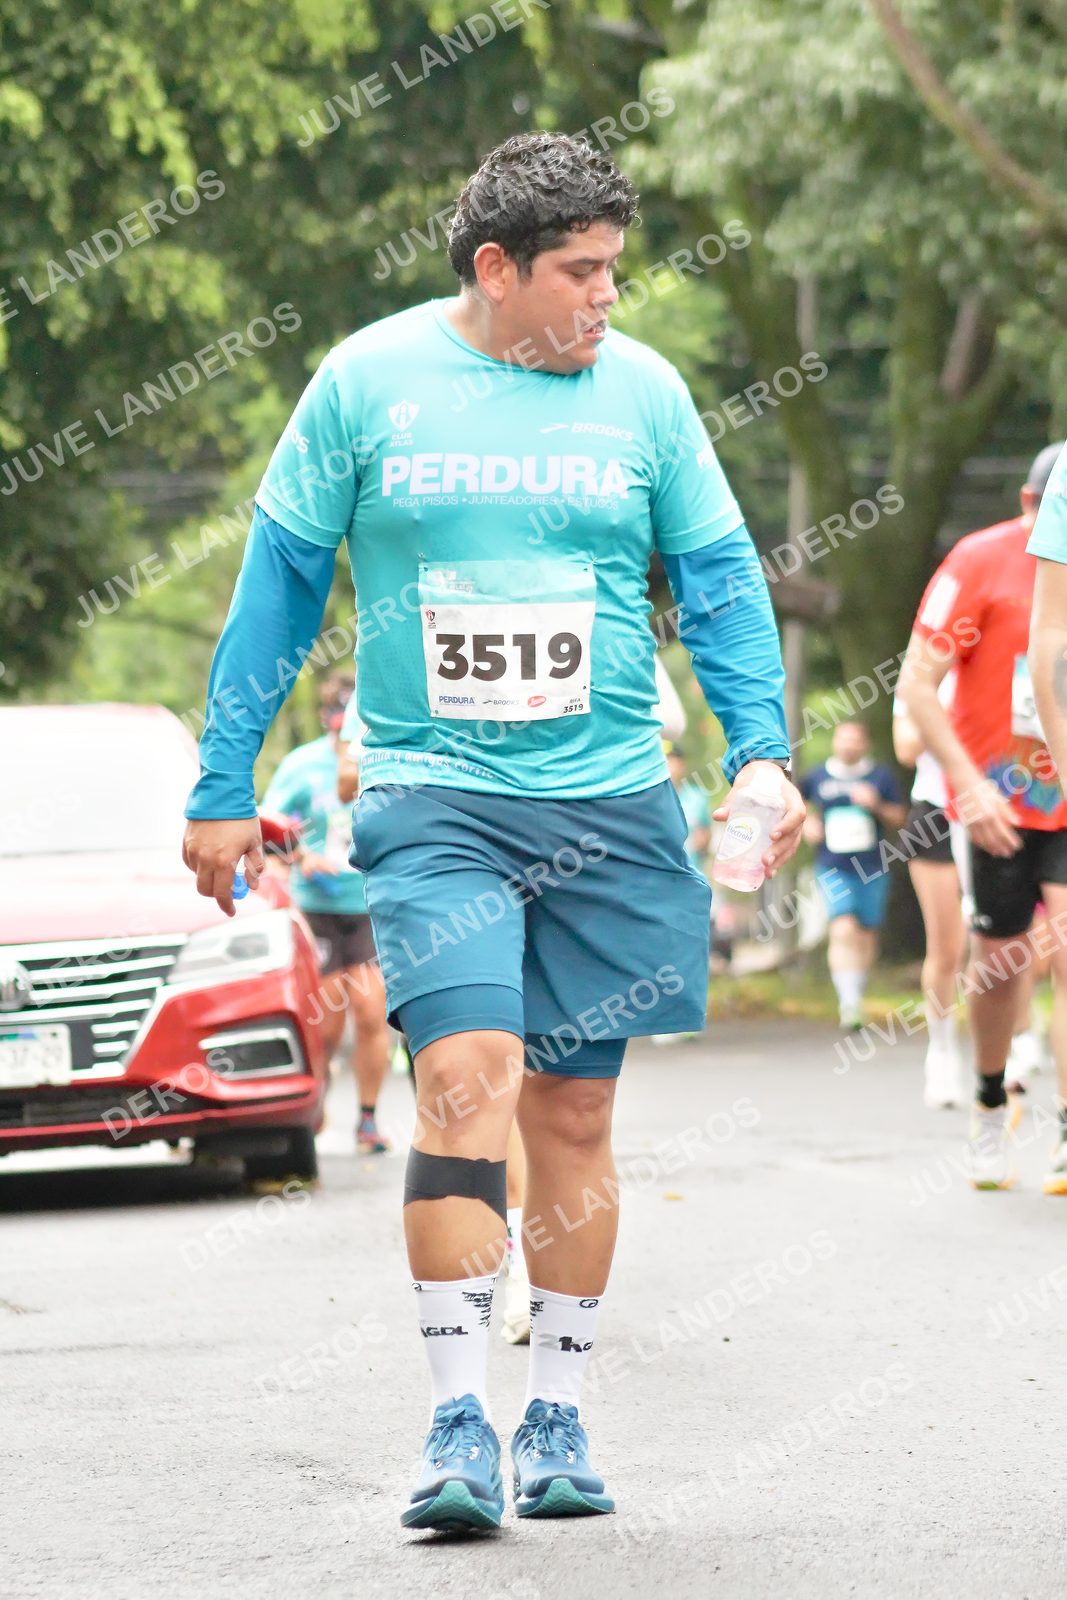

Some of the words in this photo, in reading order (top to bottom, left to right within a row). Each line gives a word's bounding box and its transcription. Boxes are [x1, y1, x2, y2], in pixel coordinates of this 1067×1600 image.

[571, 422, 633, 442] BROOKS
[389, 440, 414, 448] ATLAS
[382, 453, 629, 499] PERDURA
[393, 497, 419, 508] PEGA
[422, 495, 458, 506] PISOS
[468, 495, 558, 506] JUNTEADORES
[436, 632, 582, 681] 3519
[438, 695, 475, 704] PERDURA
[563, 703, 584, 713] 3519
